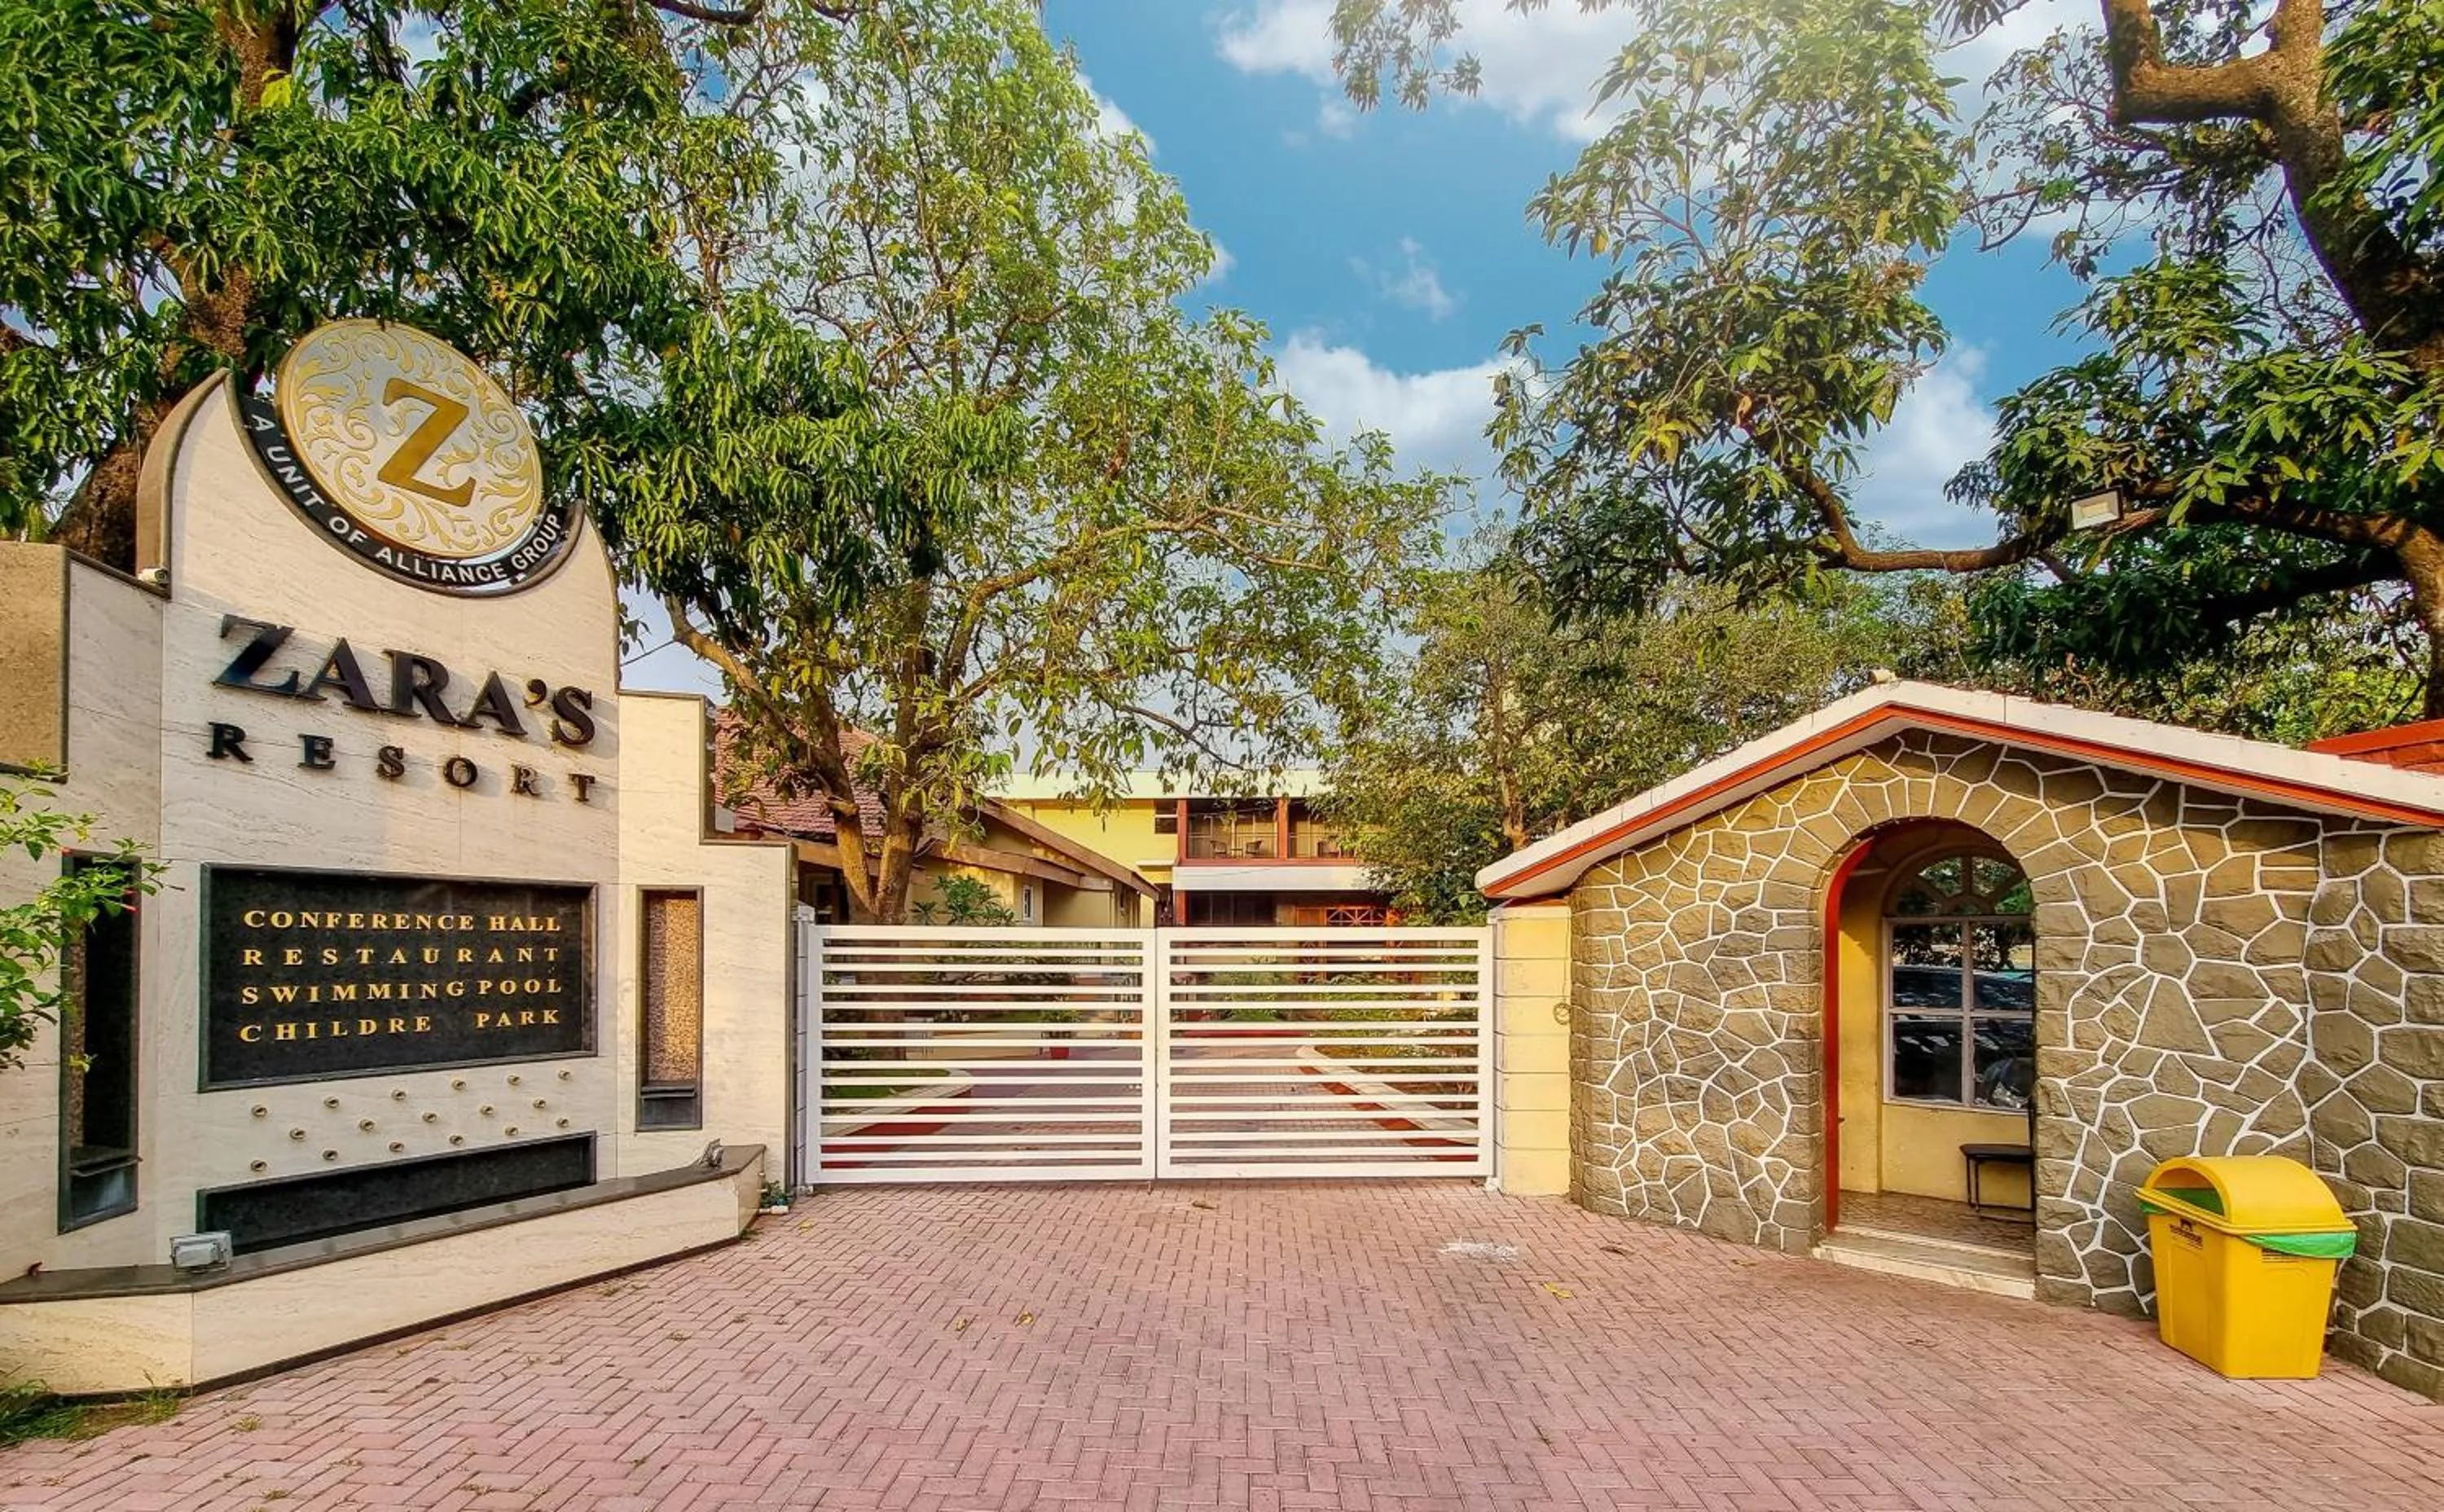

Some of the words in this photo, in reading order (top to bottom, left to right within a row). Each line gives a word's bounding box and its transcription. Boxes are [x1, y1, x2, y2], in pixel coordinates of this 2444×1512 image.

[250, 413, 275, 433] A
[266, 444, 325, 508] UNIT
[327, 516, 371, 545] OF
[375, 546, 508, 583] ALLIANCE
[512, 512, 561, 570] GROUP
[210, 613, 596, 747] ZARA'S
[206, 721, 596, 802] RESORT
[244, 910, 474, 931] CONFERENCE
[489, 916, 561, 932] HALL
[242, 947, 559, 966] RESTAURANT
[241, 980, 466, 1005] SWIMMING
[476, 978, 562, 996] POOL
[239, 1015, 433, 1043] CHILDRE
[475, 1009, 560, 1028] PARK
